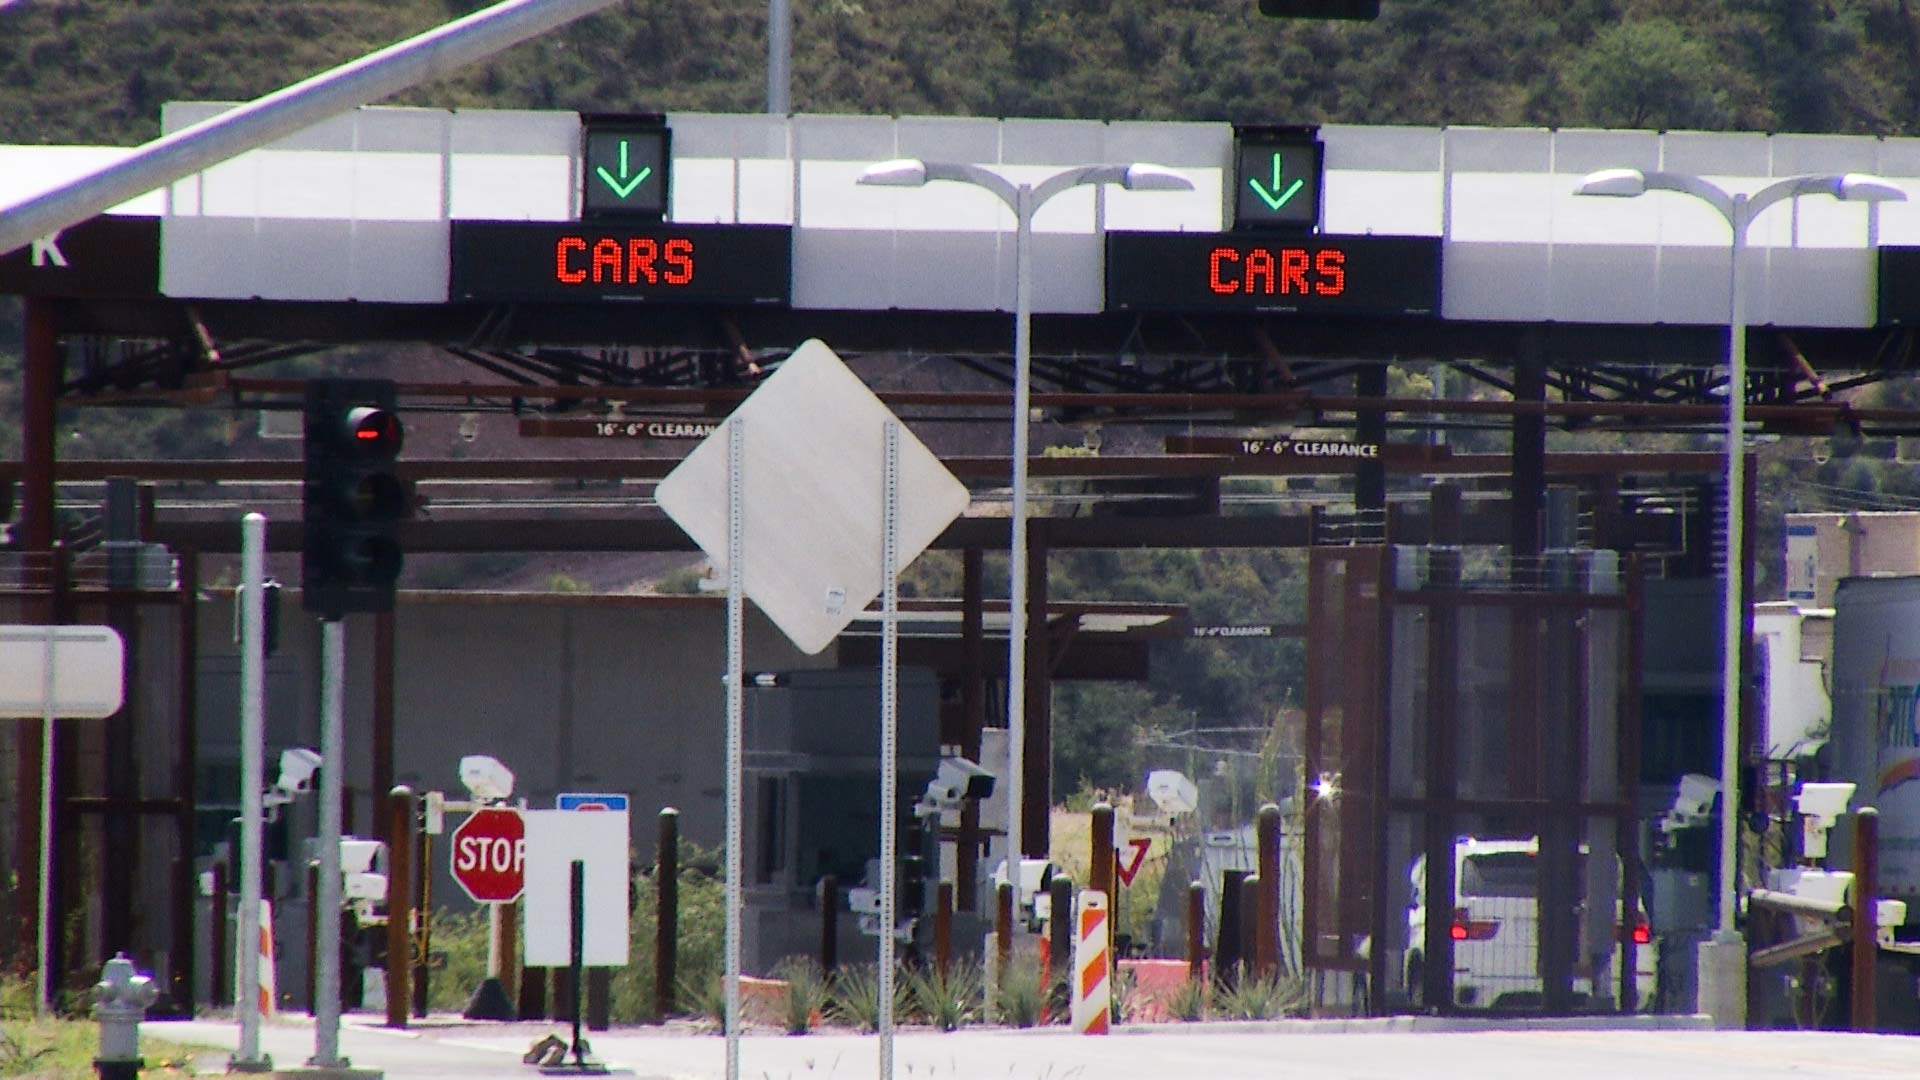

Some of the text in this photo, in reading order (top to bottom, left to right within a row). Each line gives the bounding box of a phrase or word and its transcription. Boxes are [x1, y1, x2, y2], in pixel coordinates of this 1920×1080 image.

[557, 237, 693, 284] CARS
[1210, 249, 1345, 296] CARS
[1294, 442, 1379, 458] CLEARANCE
